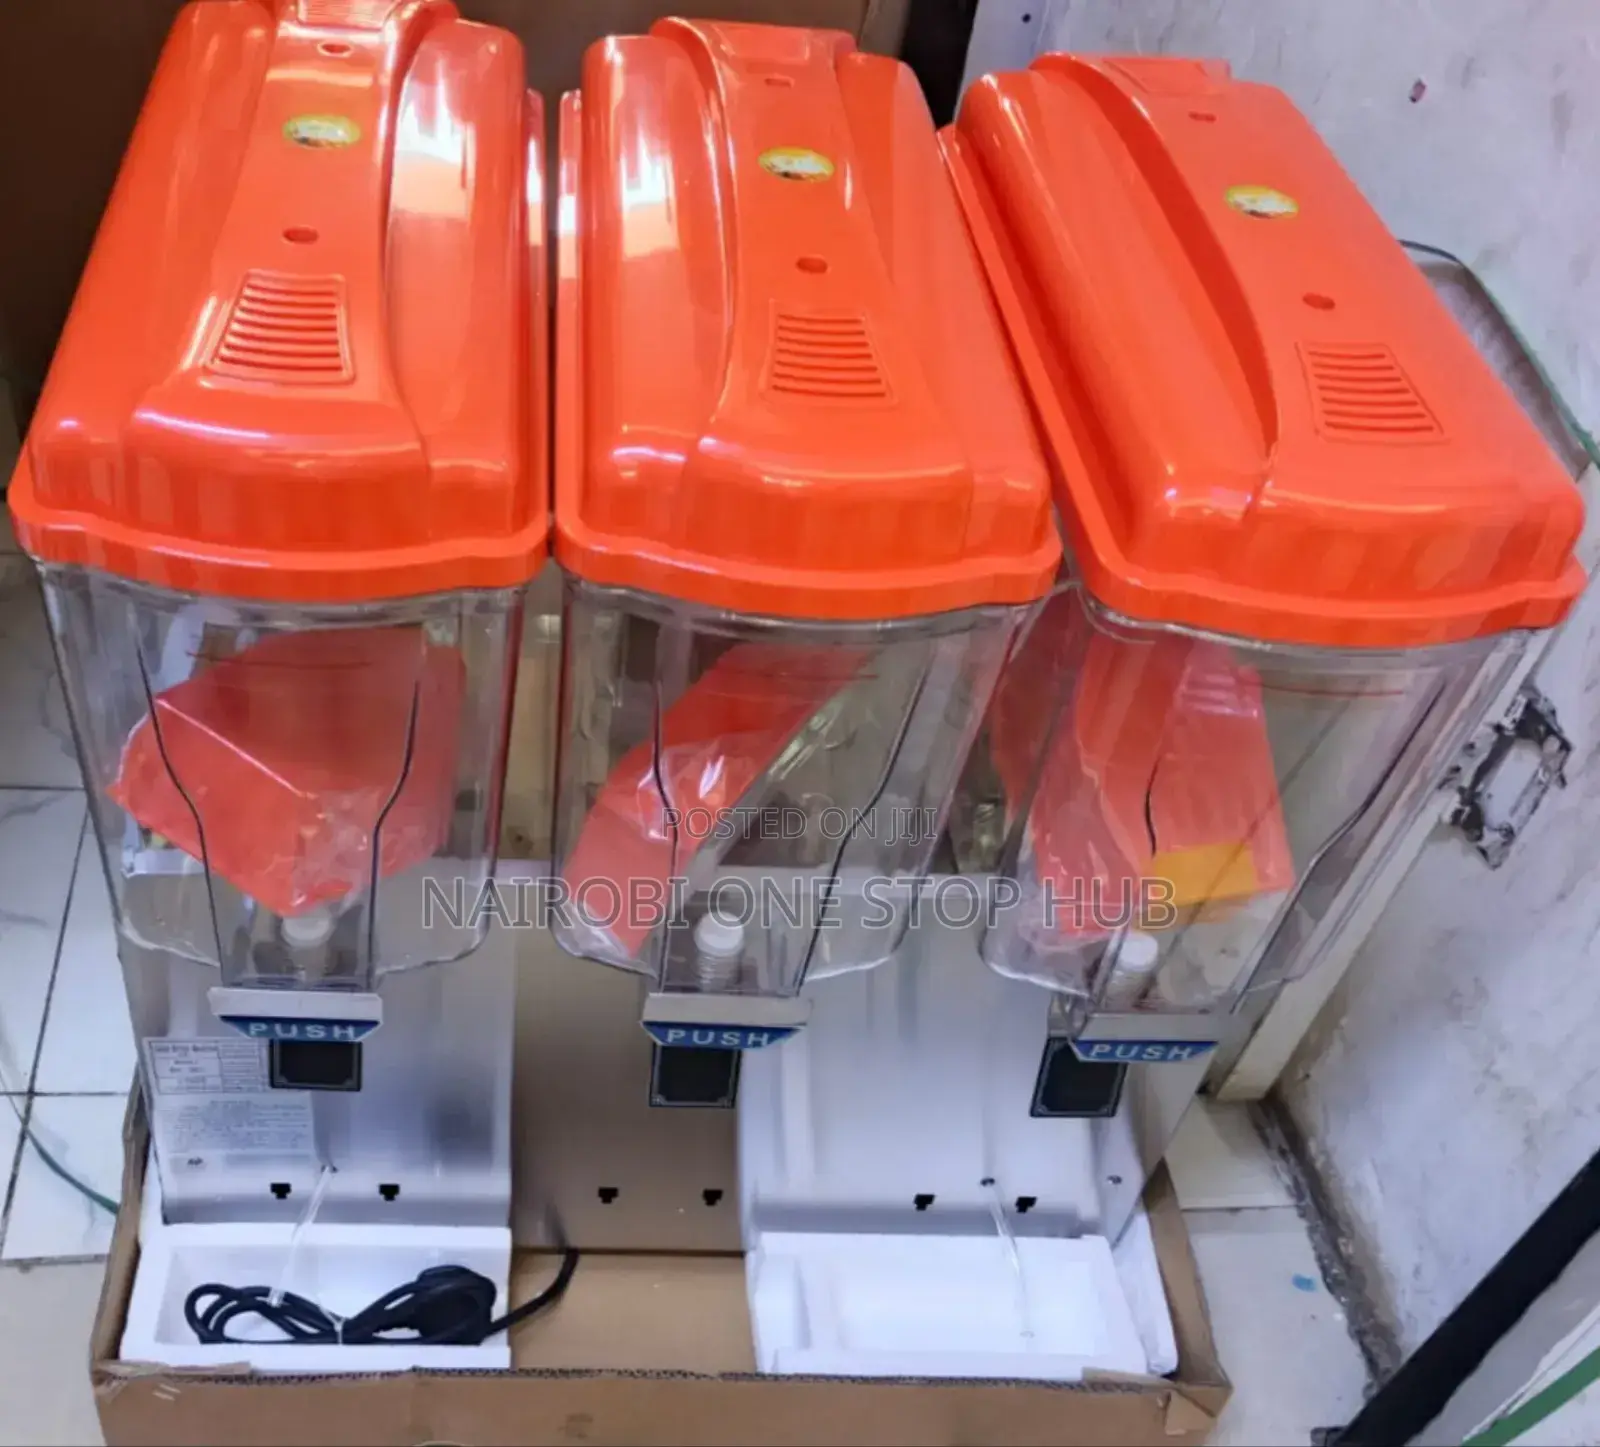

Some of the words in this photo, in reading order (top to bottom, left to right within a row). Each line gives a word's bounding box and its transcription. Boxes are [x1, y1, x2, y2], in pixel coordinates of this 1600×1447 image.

[249, 1022, 355, 1041] PUSH
[667, 1028, 769, 1046] PUSH
[1090, 1043, 1192, 1060] PUSH
